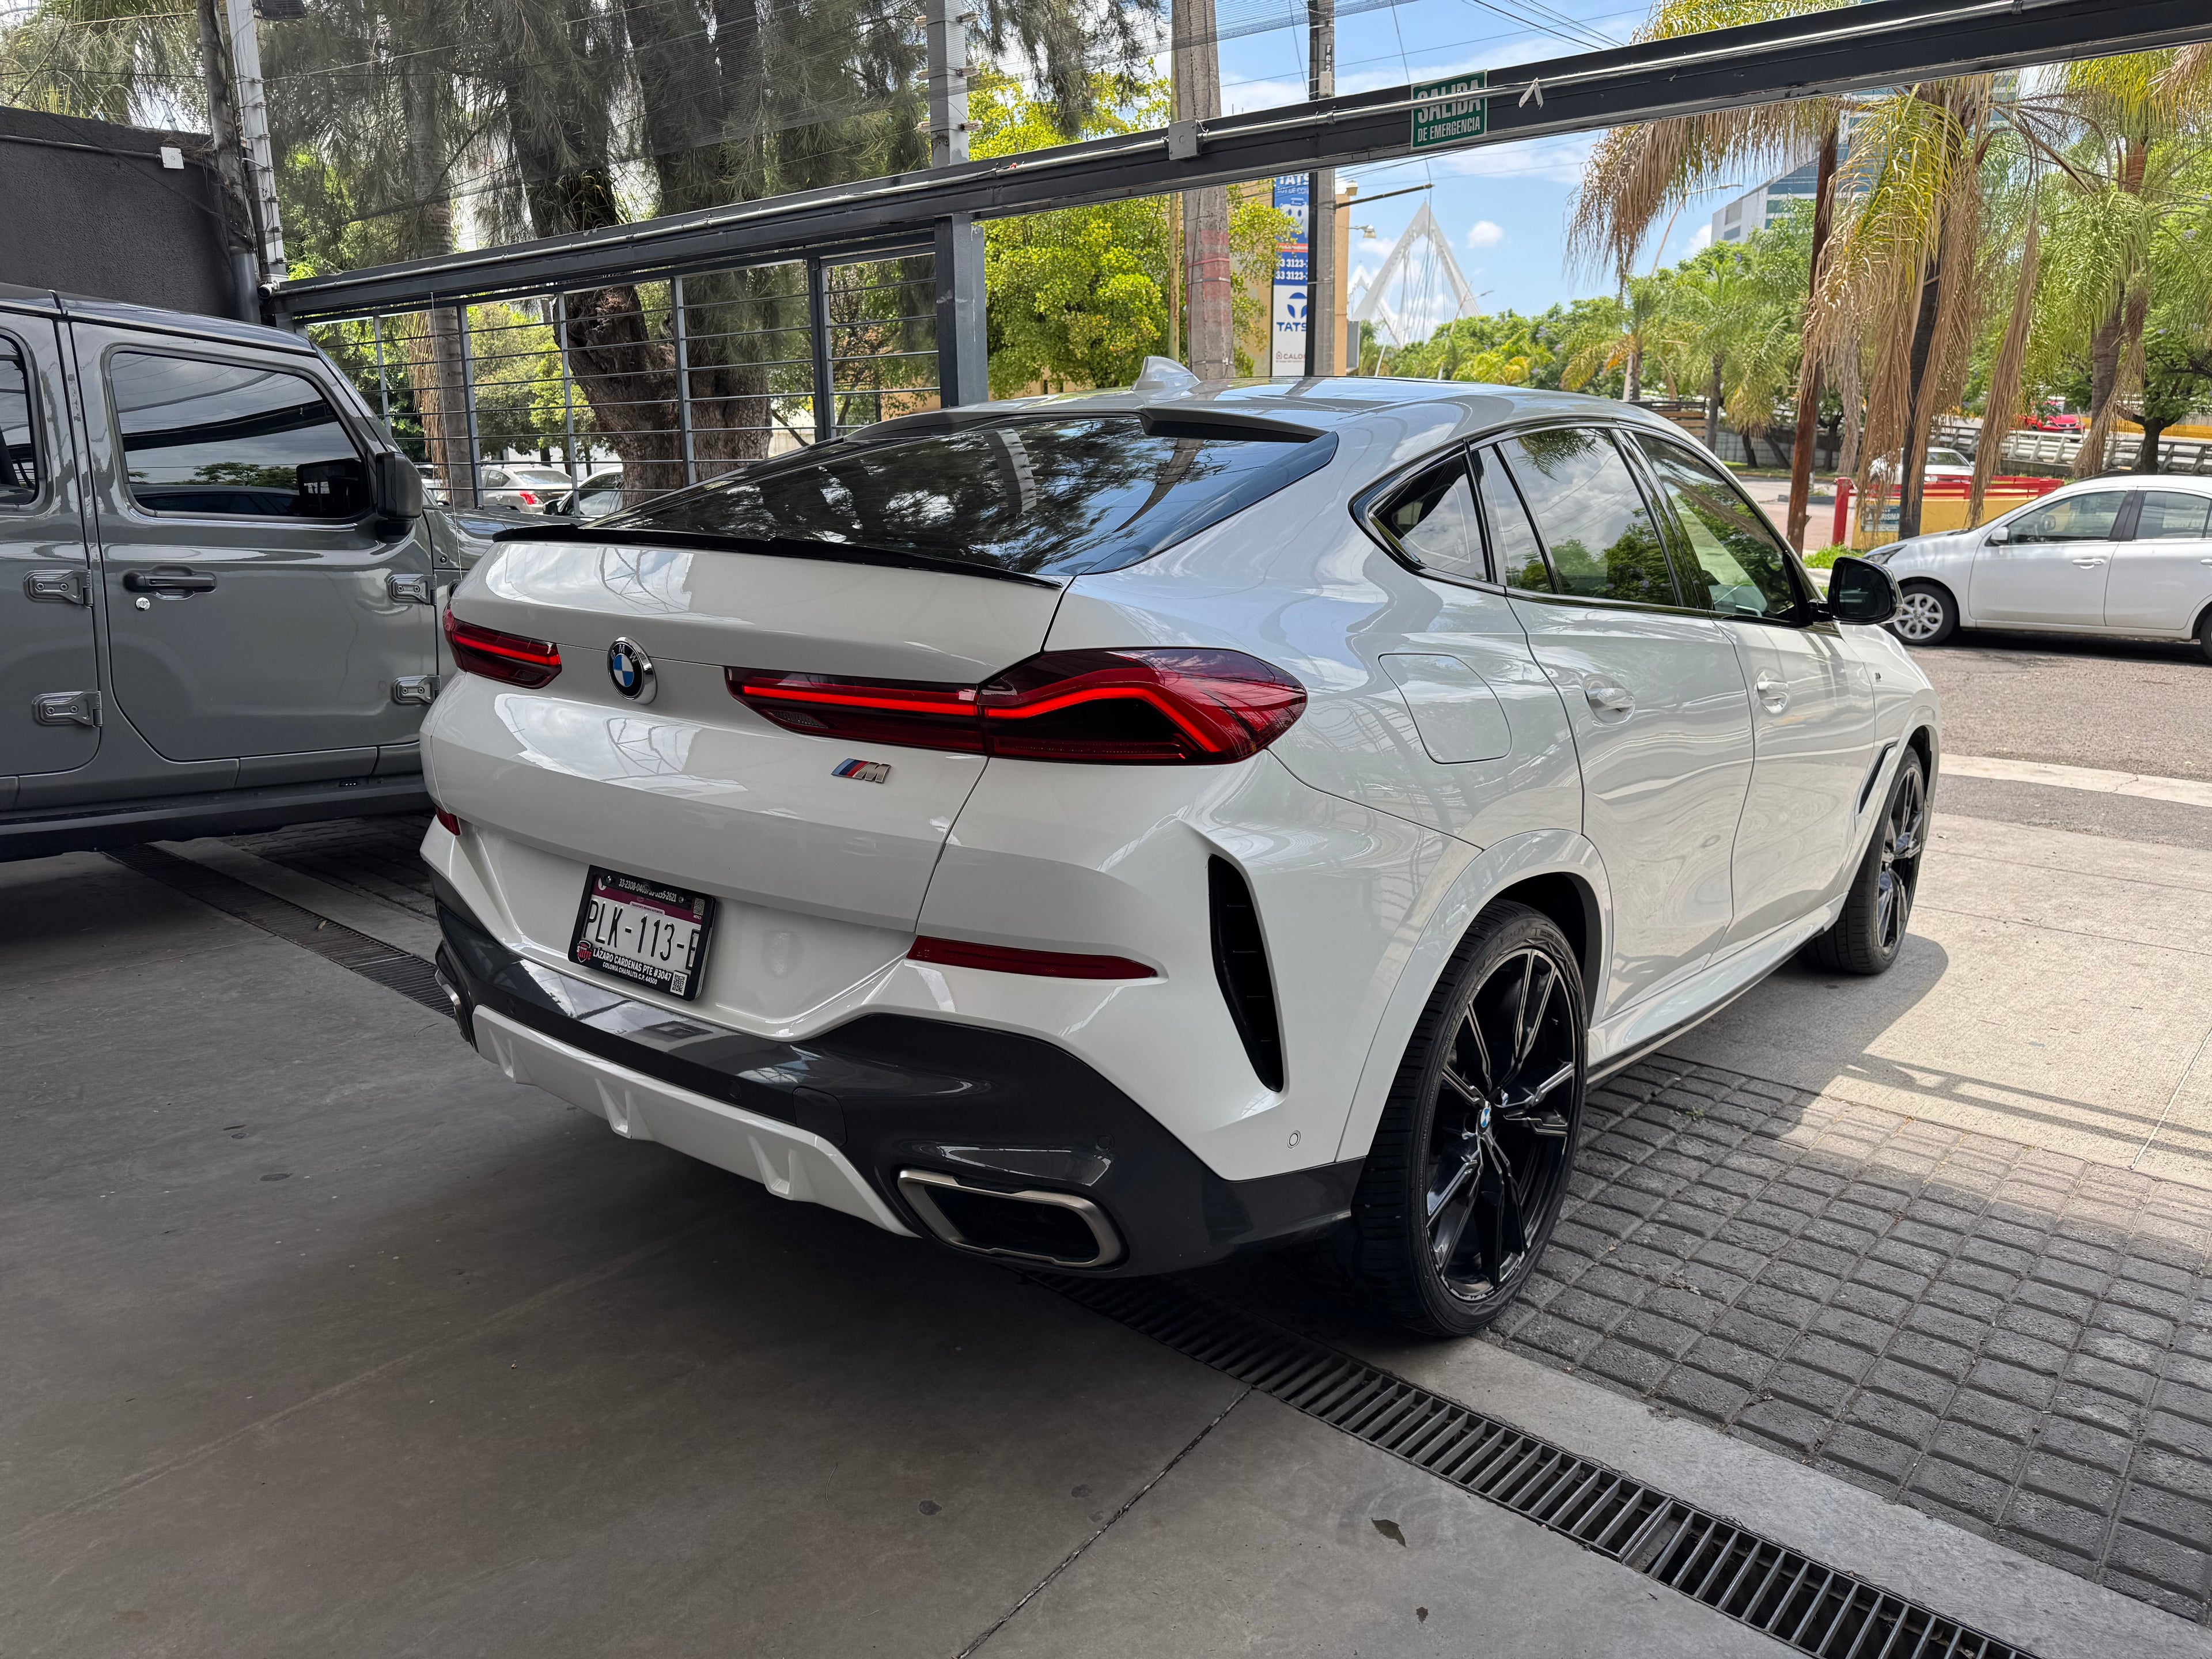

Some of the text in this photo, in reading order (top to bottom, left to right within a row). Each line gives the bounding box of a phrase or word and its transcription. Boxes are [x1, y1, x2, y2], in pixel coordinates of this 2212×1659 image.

[1417, 79, 1481, 123] SALIDA
[1418, 116, 1480, 142] DE EMERGENCIA
[611, 644, 638, 663] BMW
[852, 761, 892, 784] M
[593, 948, 613, 963] LÁZARO
[614, 955, 642, 972] CARDENAS
[642, 964, 653, 976] PTE
[653, 969, 672, 982] #3047
[603, 961, 618, 972] COLONIA
[618, 967, 638, 979] CHAPALITA
